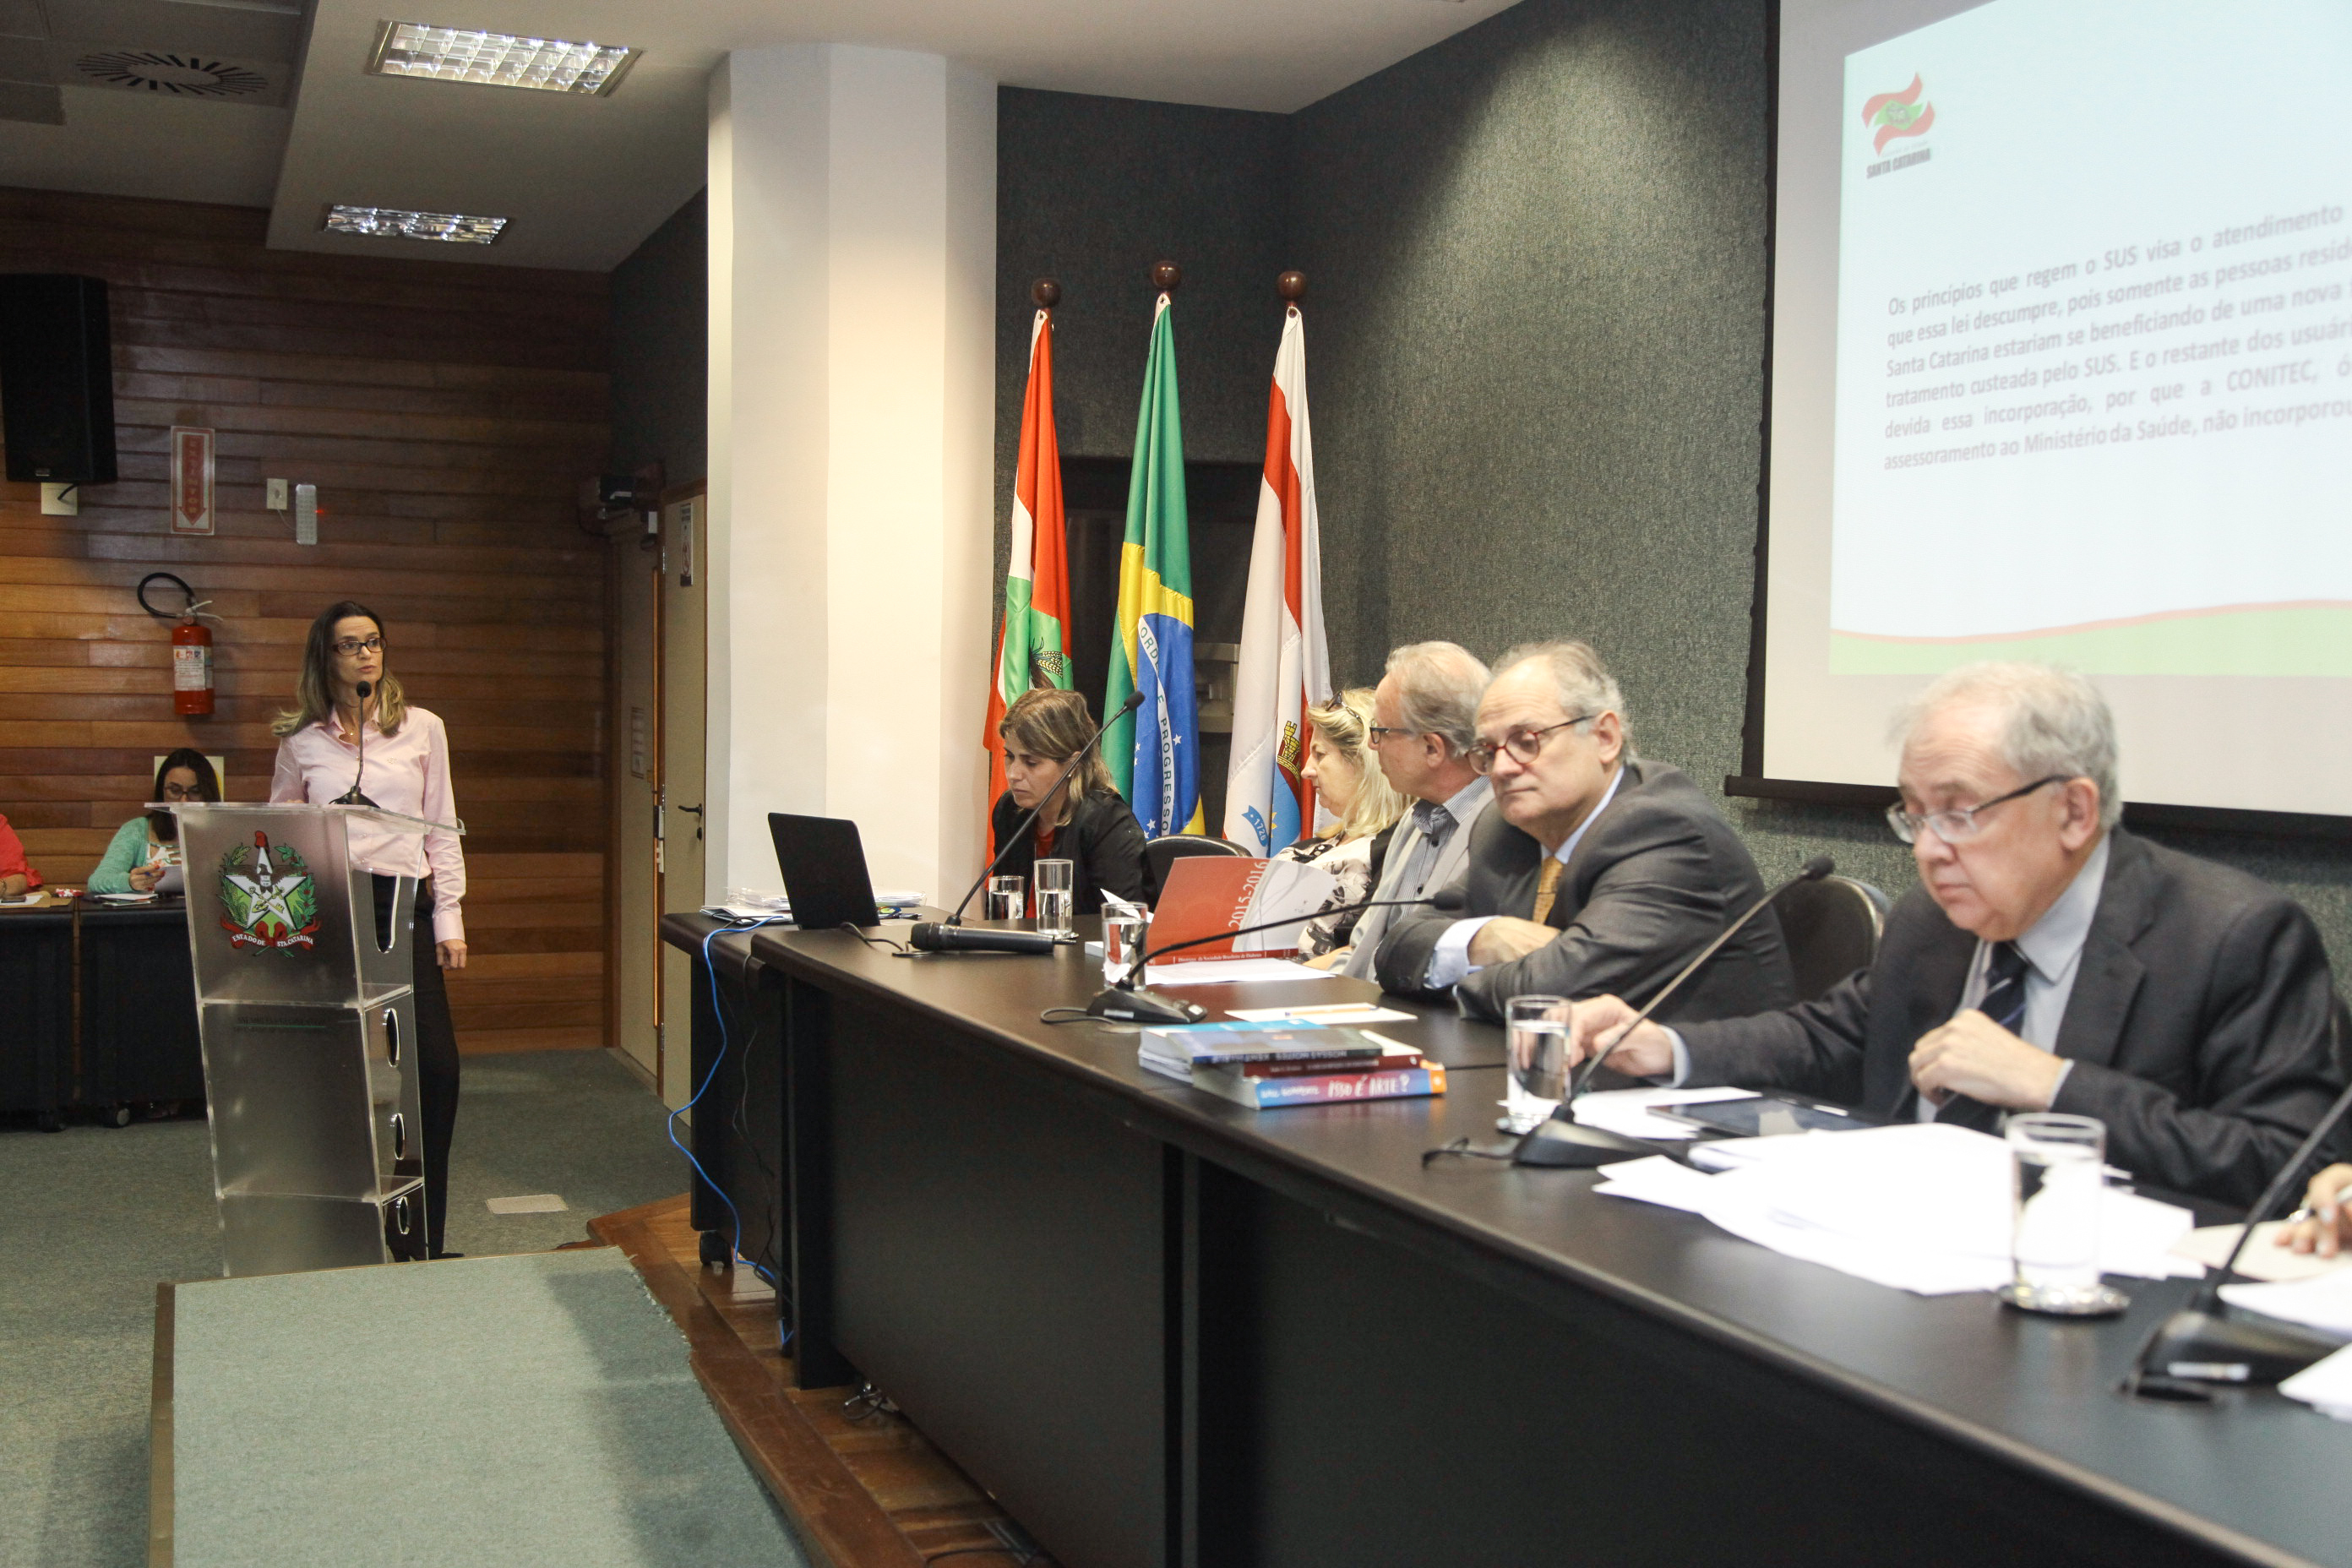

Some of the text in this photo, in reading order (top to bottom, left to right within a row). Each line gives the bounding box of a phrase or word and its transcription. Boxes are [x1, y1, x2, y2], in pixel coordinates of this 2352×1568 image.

[1867, 161, 1891, 178] SANTA
[1892, 148, 1930, 171] CATARINA
[1888, 237, 2352, 350] que essa lei descumpre, pois somente as pessoas resid
[1889, 207, 2342, 315] Os princípios que regem o SUS visa o atendimento
[1887, 384, 1963, 406] tratamento
[1972, 369, 2037, 394] custeada
[2043, 362, 2078, 388] pelo
[2085, 354, 2121, 377] SUS.
[2130, 351, 2138, 370] E
[2146, 352, 2157, 368] o
[2164, 339, 2238, 363] restante
[2248, 330, 2284, 351] dos
[1888, 285, 2341, 376] Santa Catarina estariam se beneficiando de uma nova
[1886, 417, 1930, 437] devida
[1942, 414, 1973, 430] essa
[1985, 395, 2091, 423] incorporação,
[2106, 391, 2136, 412] por
[2151, 384, 2184, 406] que
[2201, 380, 2211, 395] a
[2228, 361, 2317, 390] CONITEC,
[1886, 444, 1995, 469] assessoramento
[2000, 441, 2019, 455] ao
[2026, 427, 2105, 452] Ministério
[2110, 422, 2132, 443] da
[2137, 416, 2197, 439] Saúde,
[2203, 410, 2237, 432] não
[1161, 717, 1173, 832] PROGRESSO
[1254, 818, 1267, 841] 1726
[1228, 861, 1268, 928] 2015-2016
[232, 934, 257, 944] ESTADO
